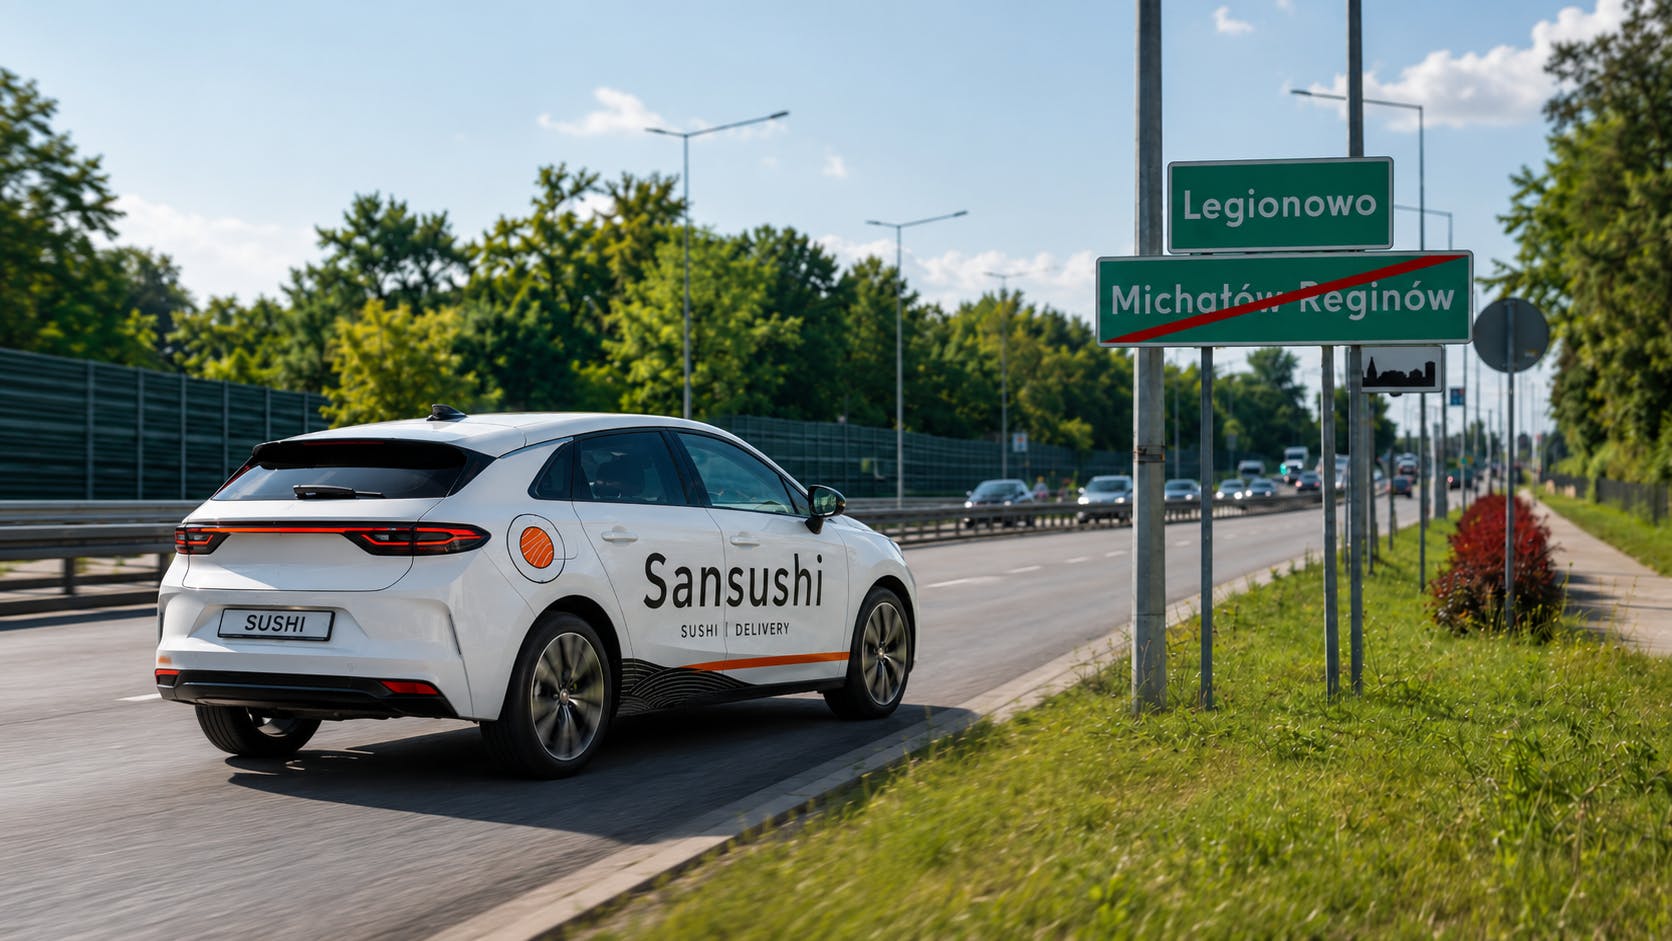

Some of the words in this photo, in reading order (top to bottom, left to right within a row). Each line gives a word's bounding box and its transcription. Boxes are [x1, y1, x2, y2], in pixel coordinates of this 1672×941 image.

[1184, 188, 1377, 228] Legionowo
[1300, 280, 1455, 321] Reginów
[643, 552, 823, 609] Sansushi
[244, 614, 306, 633] SUSHI
[680, 624, 718, 638] SUSHI
[735, 622, 790, 637] DELIVERY
